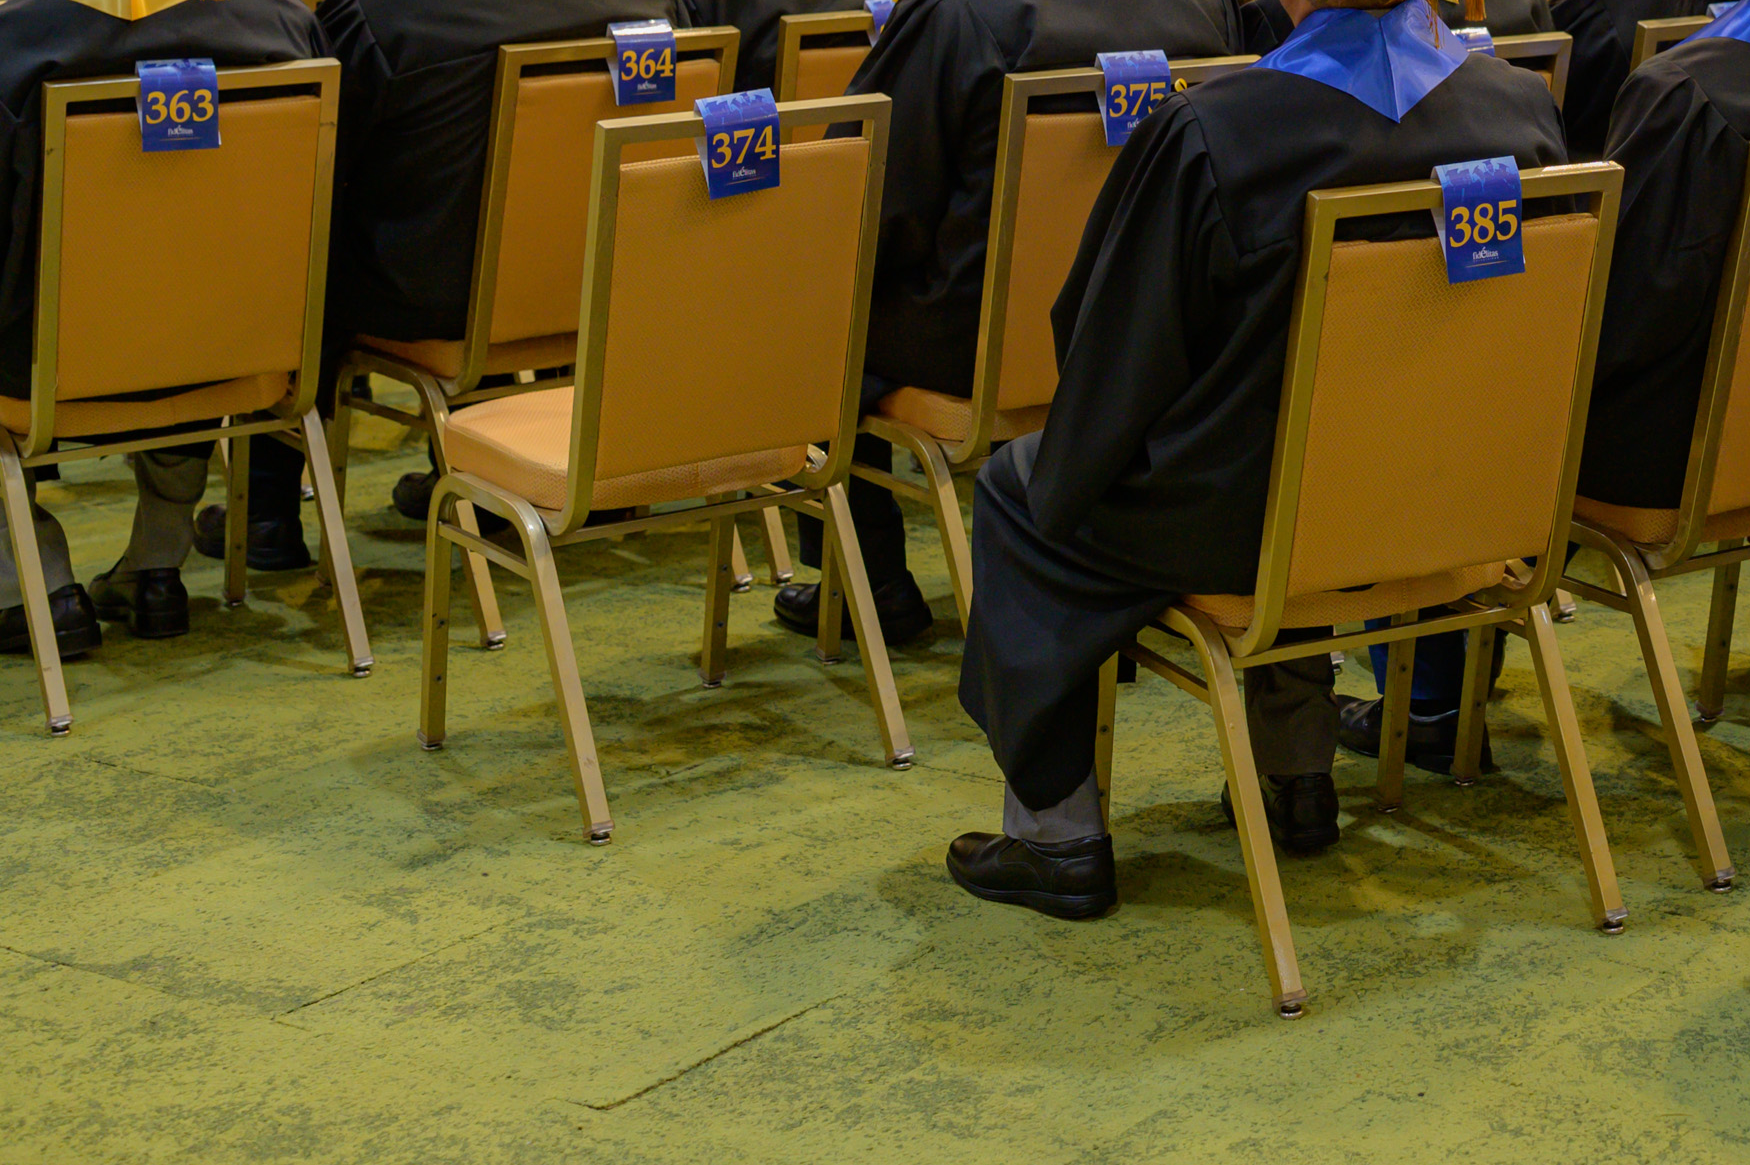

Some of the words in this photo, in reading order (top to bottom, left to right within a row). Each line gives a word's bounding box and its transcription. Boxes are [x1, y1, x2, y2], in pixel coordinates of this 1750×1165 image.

[621, 47, 674, 81] 364
[145, 88, 214, 124] 363
[1109, 82, 1166, 118] 375
[711, 125, 776, 169] 374
[1449, 199, 1518, 248] 385
